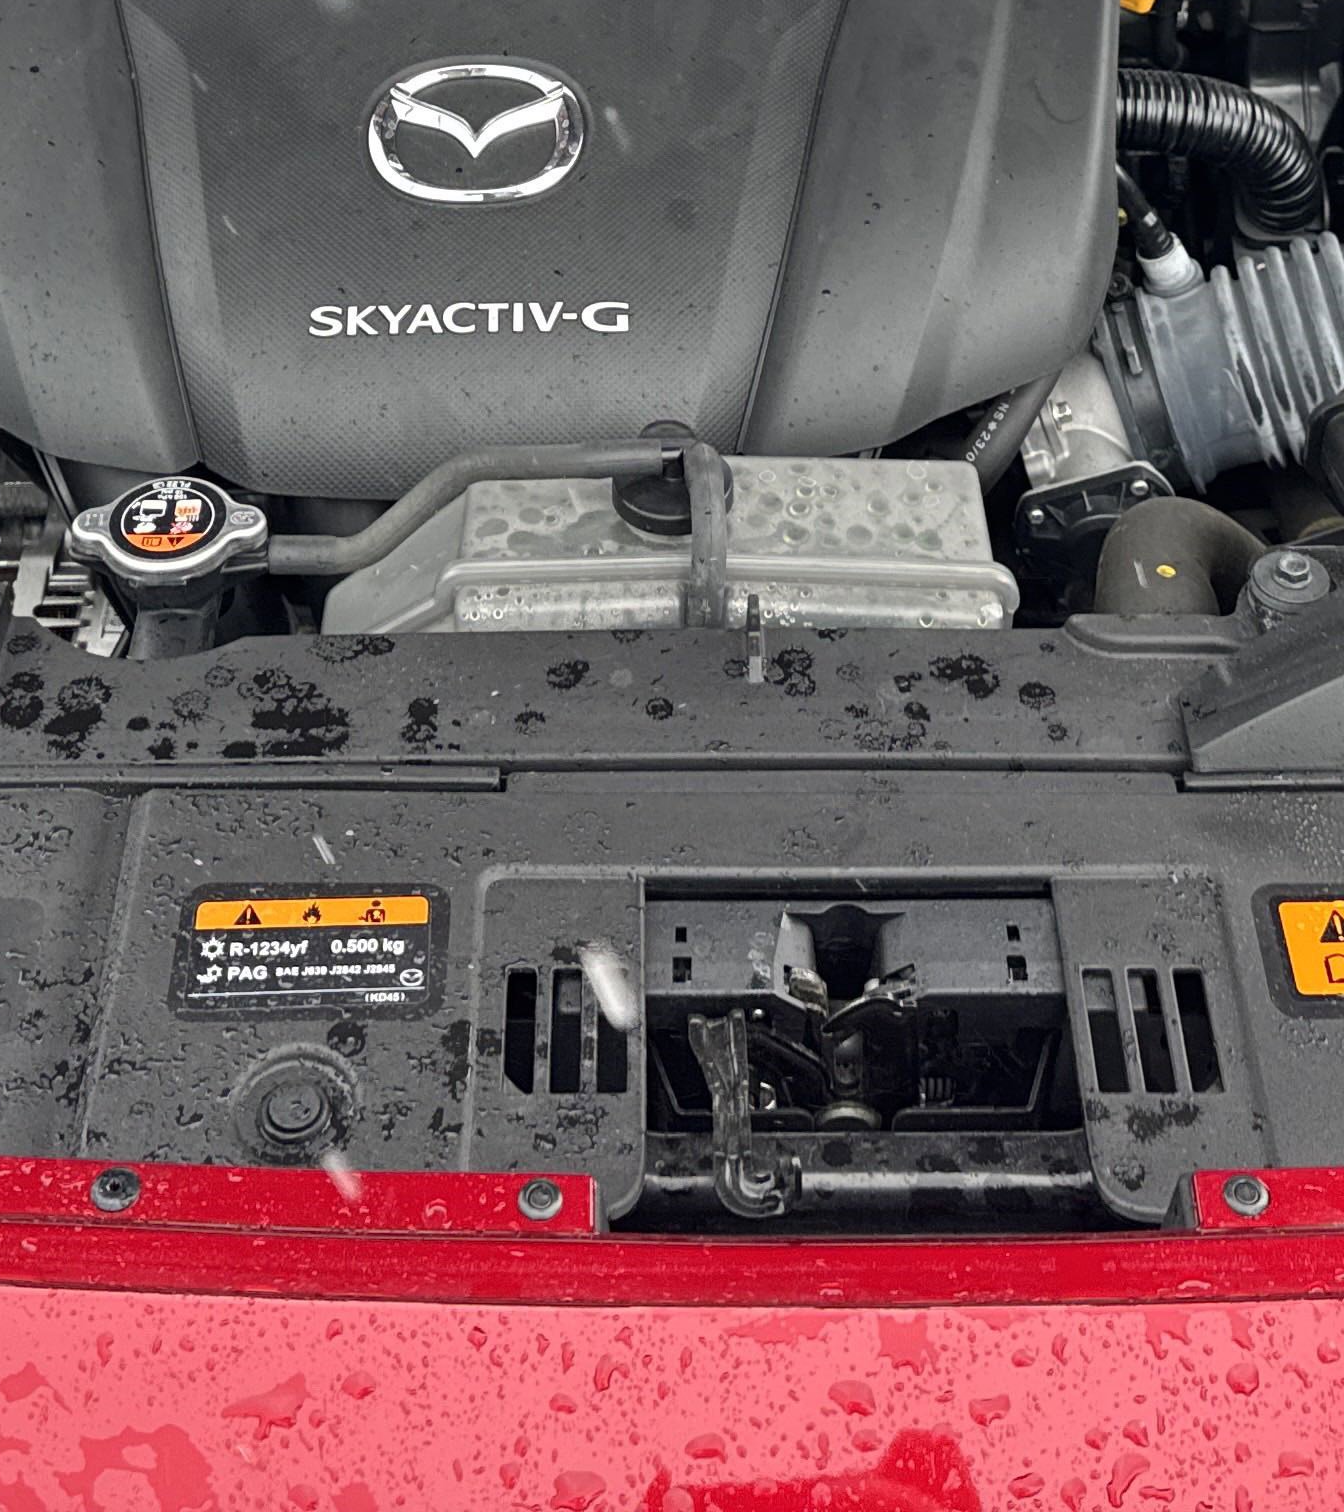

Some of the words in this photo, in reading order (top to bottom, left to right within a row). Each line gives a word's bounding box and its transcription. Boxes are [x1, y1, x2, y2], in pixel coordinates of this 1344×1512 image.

[307, 300, 630, 337] SKYACTIV-G
[229, 939, 309, 958] R-1234yf
[330, 938, 379, 954] 0.500
[382, 937, 405, 956] kg
[227, 965, 268, 981] PAG
